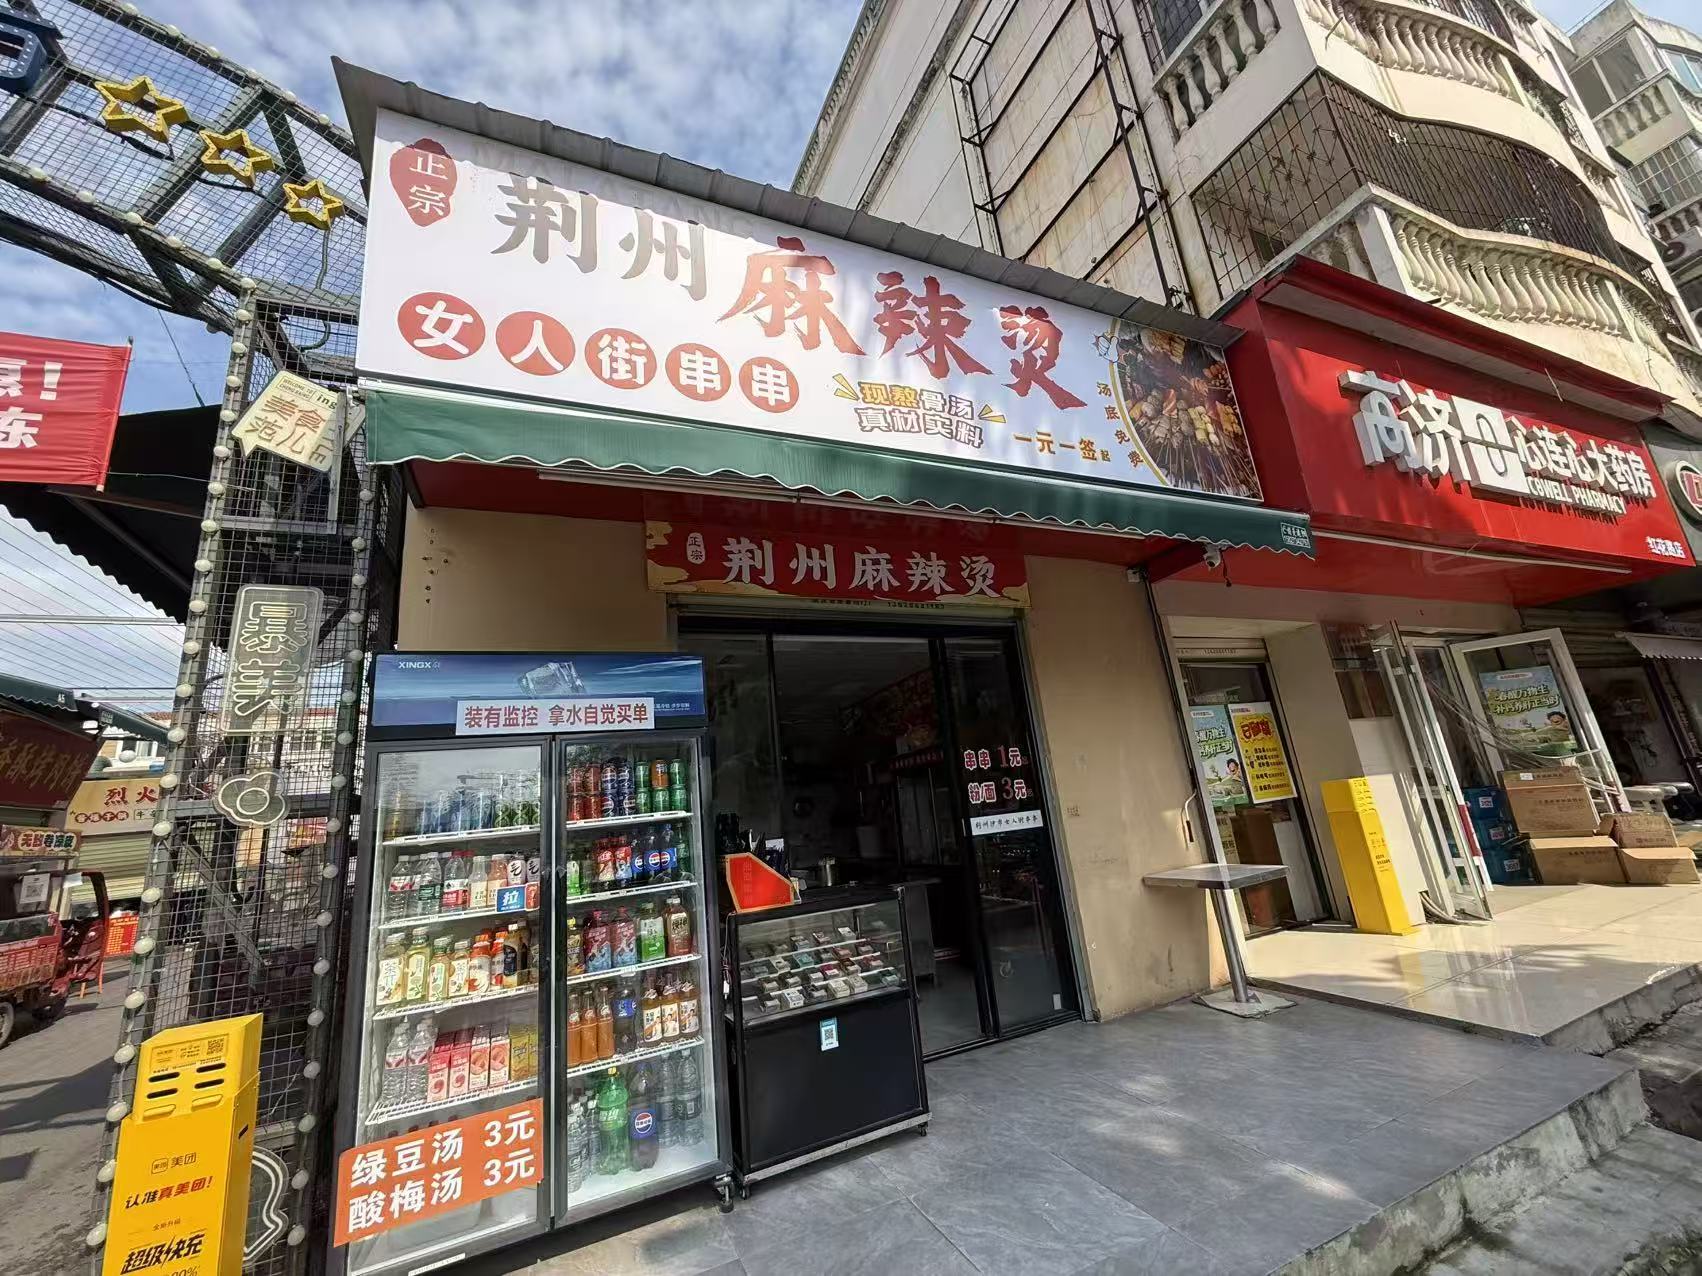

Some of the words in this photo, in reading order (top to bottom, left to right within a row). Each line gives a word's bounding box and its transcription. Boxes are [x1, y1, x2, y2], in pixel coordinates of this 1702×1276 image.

[407, 150, 450, 217] 正宗
[490, 172, 1088, 411] 荆州麻辣烫
[412, 300, 792, 407] 女人街串串
[261, 395, 326, 434] 美食
[857, 381, 975, 420] 现熬骨汤
[854, 407, 984, 449] 真材实料
[1096, 382, 1144, 469] 汤底免费
[1338, 370, 1471, 485] 高济
[1508, 415, 1656, 499] 心连心大药房
[1526, 476, 1573, 503] COWELL
[1572, 485, 1627, 514] PHARMACY
[688, 535, 704, 562] 正宗
[722, 537, 1001, 599] 荆州麻辣烫
[398, 661, 432, 669] XINGX
[465, 706, 539, 730] 装有监控
[548, 703, 649, 727] 拿水自觉买单
[964, 749, 991, 770] 串串
[104, 786, 159, 806] 烈火
[968, 781, 997, 804] 粉/面
[502, 890, 519, 906] 拉
[170, 1152, 197, 1169] 美团
[351, 1127, 463, 1189] 绿豆汤
[483, 1110, 535, 1148] 3元
[125, 1176, 213, 1209] 认准真美团!
[348, 1168, 463, 1233] 酸梅汤
[483, 1149, 535, 1187] 3元
[120, 1233, 206, 1275] 超级快充
